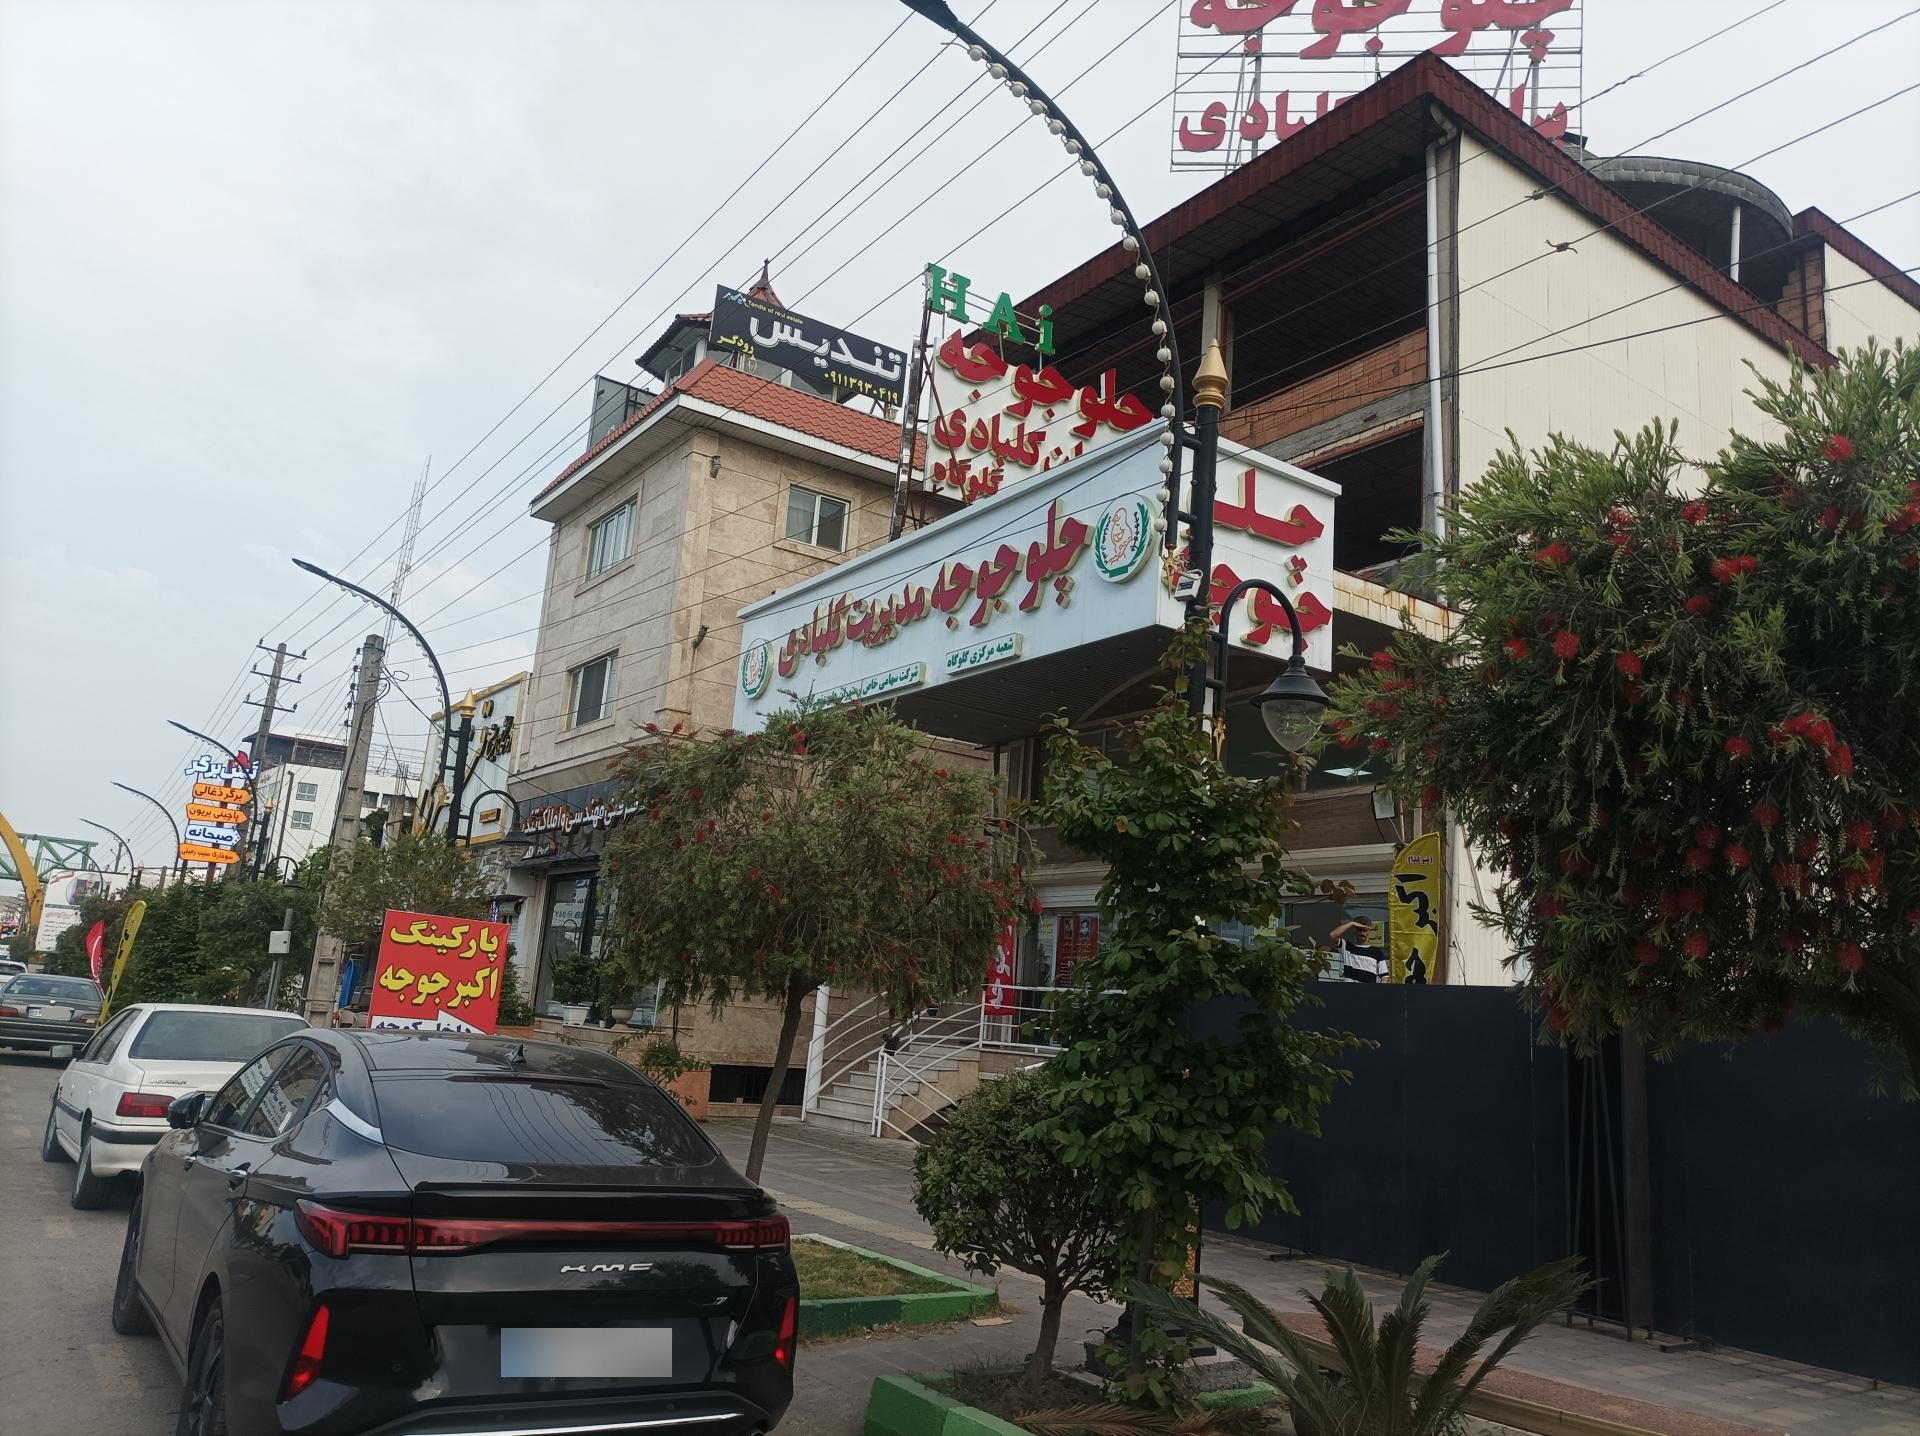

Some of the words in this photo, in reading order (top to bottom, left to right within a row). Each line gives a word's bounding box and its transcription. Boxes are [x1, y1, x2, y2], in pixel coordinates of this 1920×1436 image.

[1430, 0, 1575, 62] چو
[747, 299, 767, 311] Tandis
[750, 316, 903, 382] تندیس
[936, 329, 1076, 422] جوجه
[1019, 498, 1095, 612] چلو
[931, 543, 1025, 631] جوجه
[847, 582, 931, 648] مدیریت
[969, 645, 995, 665] مرکزی
[996, 637, 1014, 656] شعبه
[878, 673, 899, 690] سهامی
[899, 664, 919, 683] شرکت
[184, 754, 224, 780] برگر
[224, 789, 243, 801] برگر
[538, 806, 562, 831] املاک
[565, 798, 605, 833] مهندسی
[188, 827, 234, 843] صبحانه
[389, 920, 499, 962] پارکینگ
[379, 964, 451, 1005] جوجه
[446, 967, 499, 1008] اکبر
[560, 1262, 654, 1273] KMC
